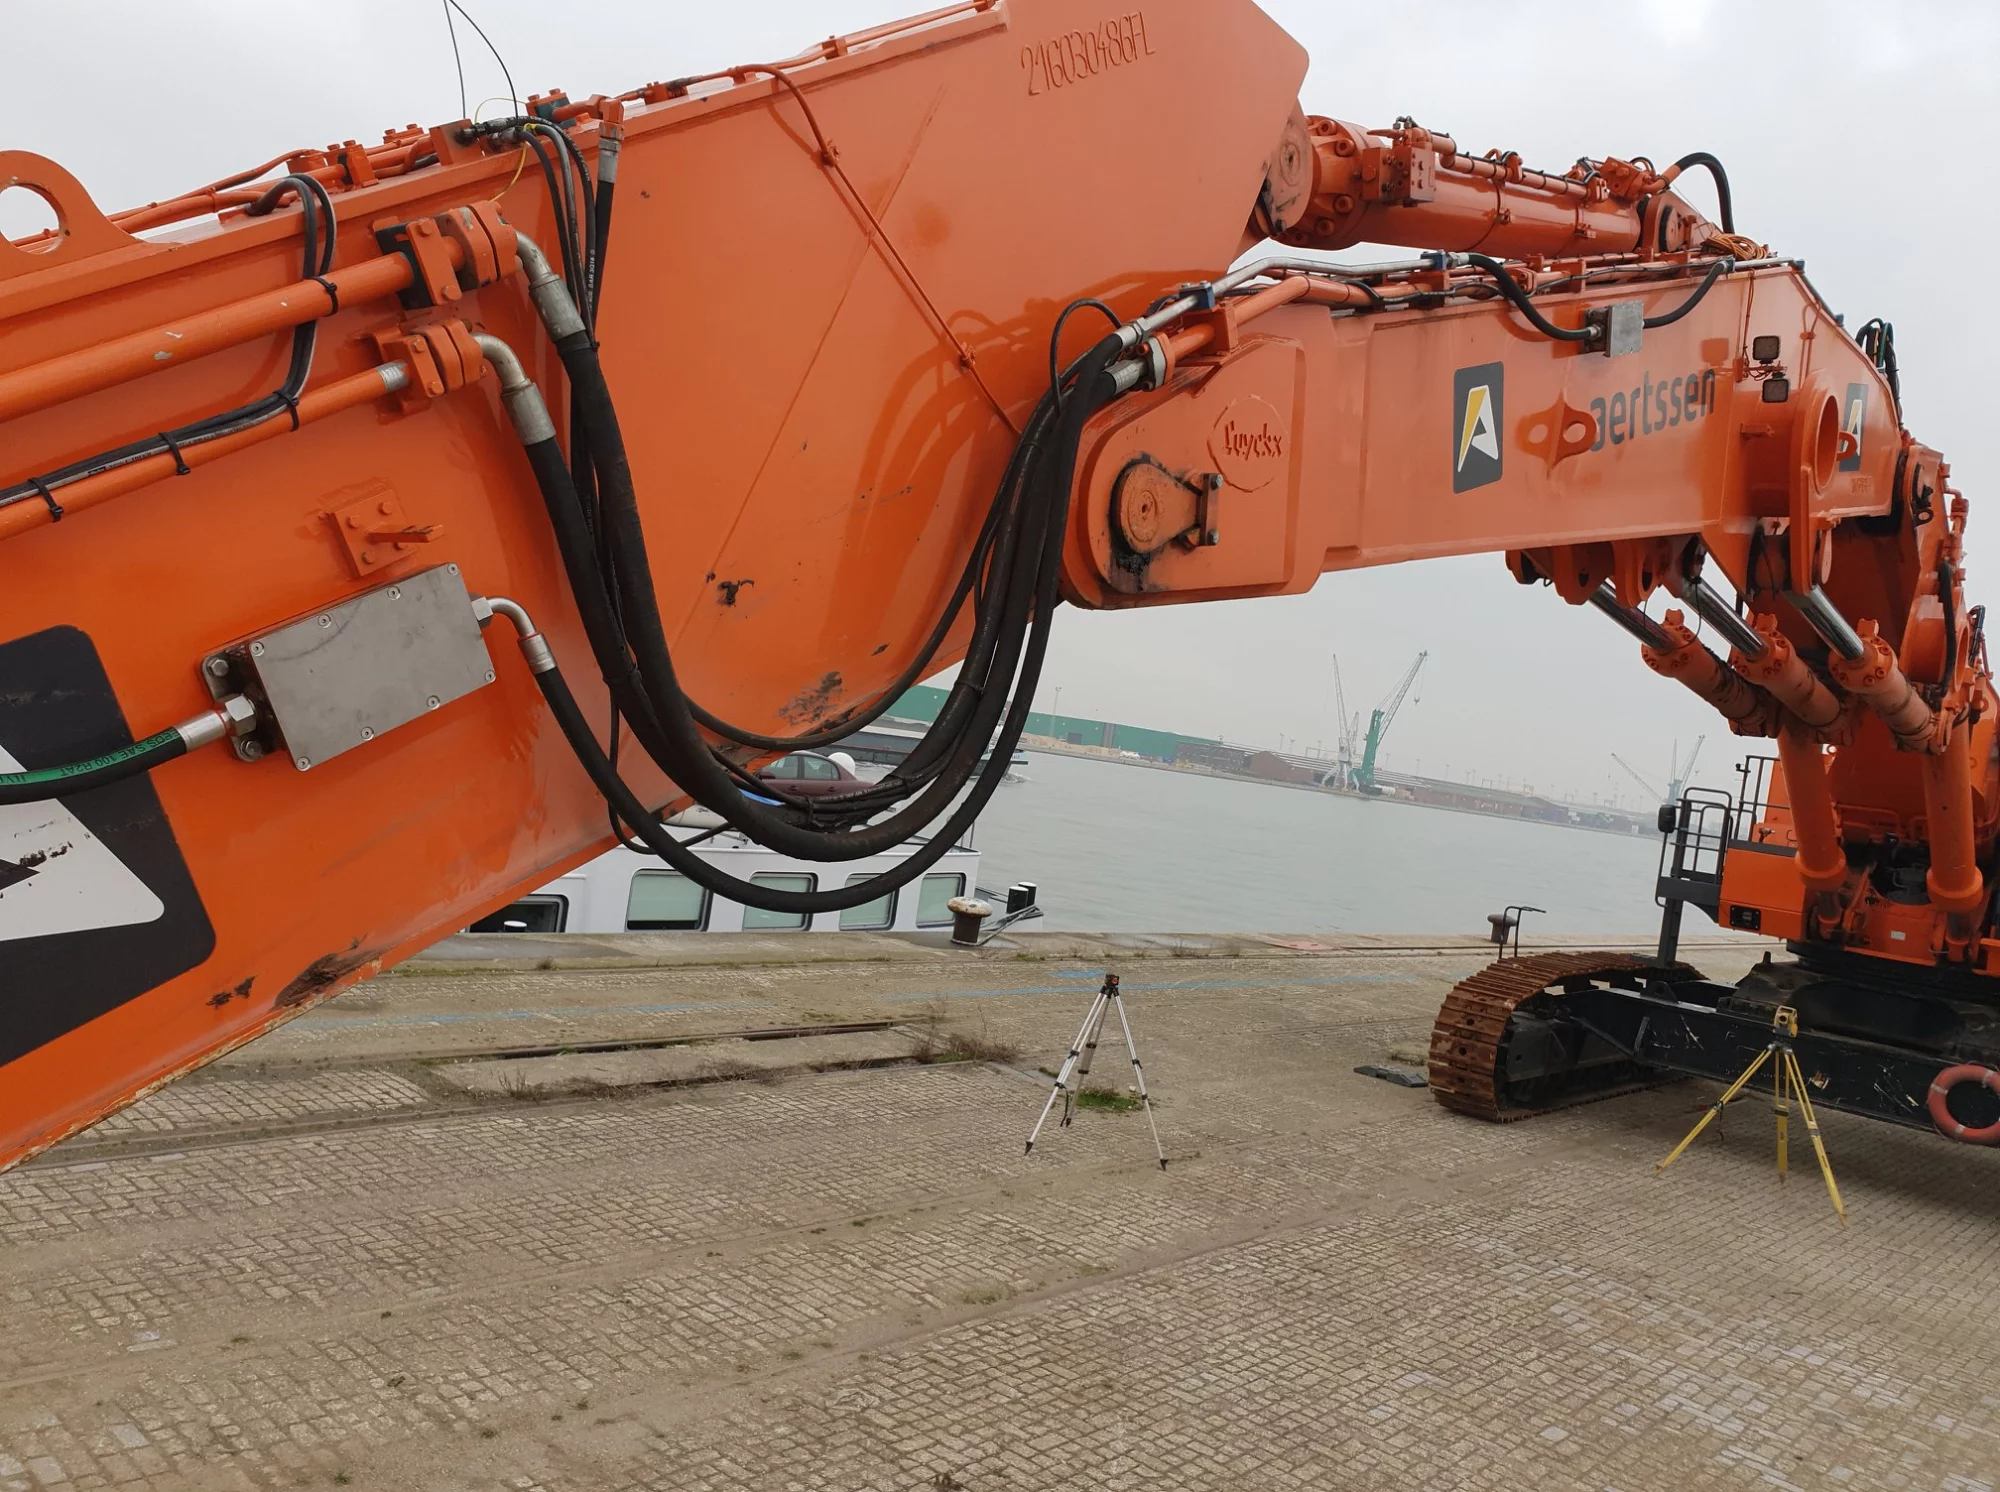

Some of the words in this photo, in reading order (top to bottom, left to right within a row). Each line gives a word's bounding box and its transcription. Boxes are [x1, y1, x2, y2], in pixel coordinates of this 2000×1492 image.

[1589, 368, 1716, 452] aertssen
[94, 755, 117, 767] 100
[60, 762, 93, 777] R2AT
